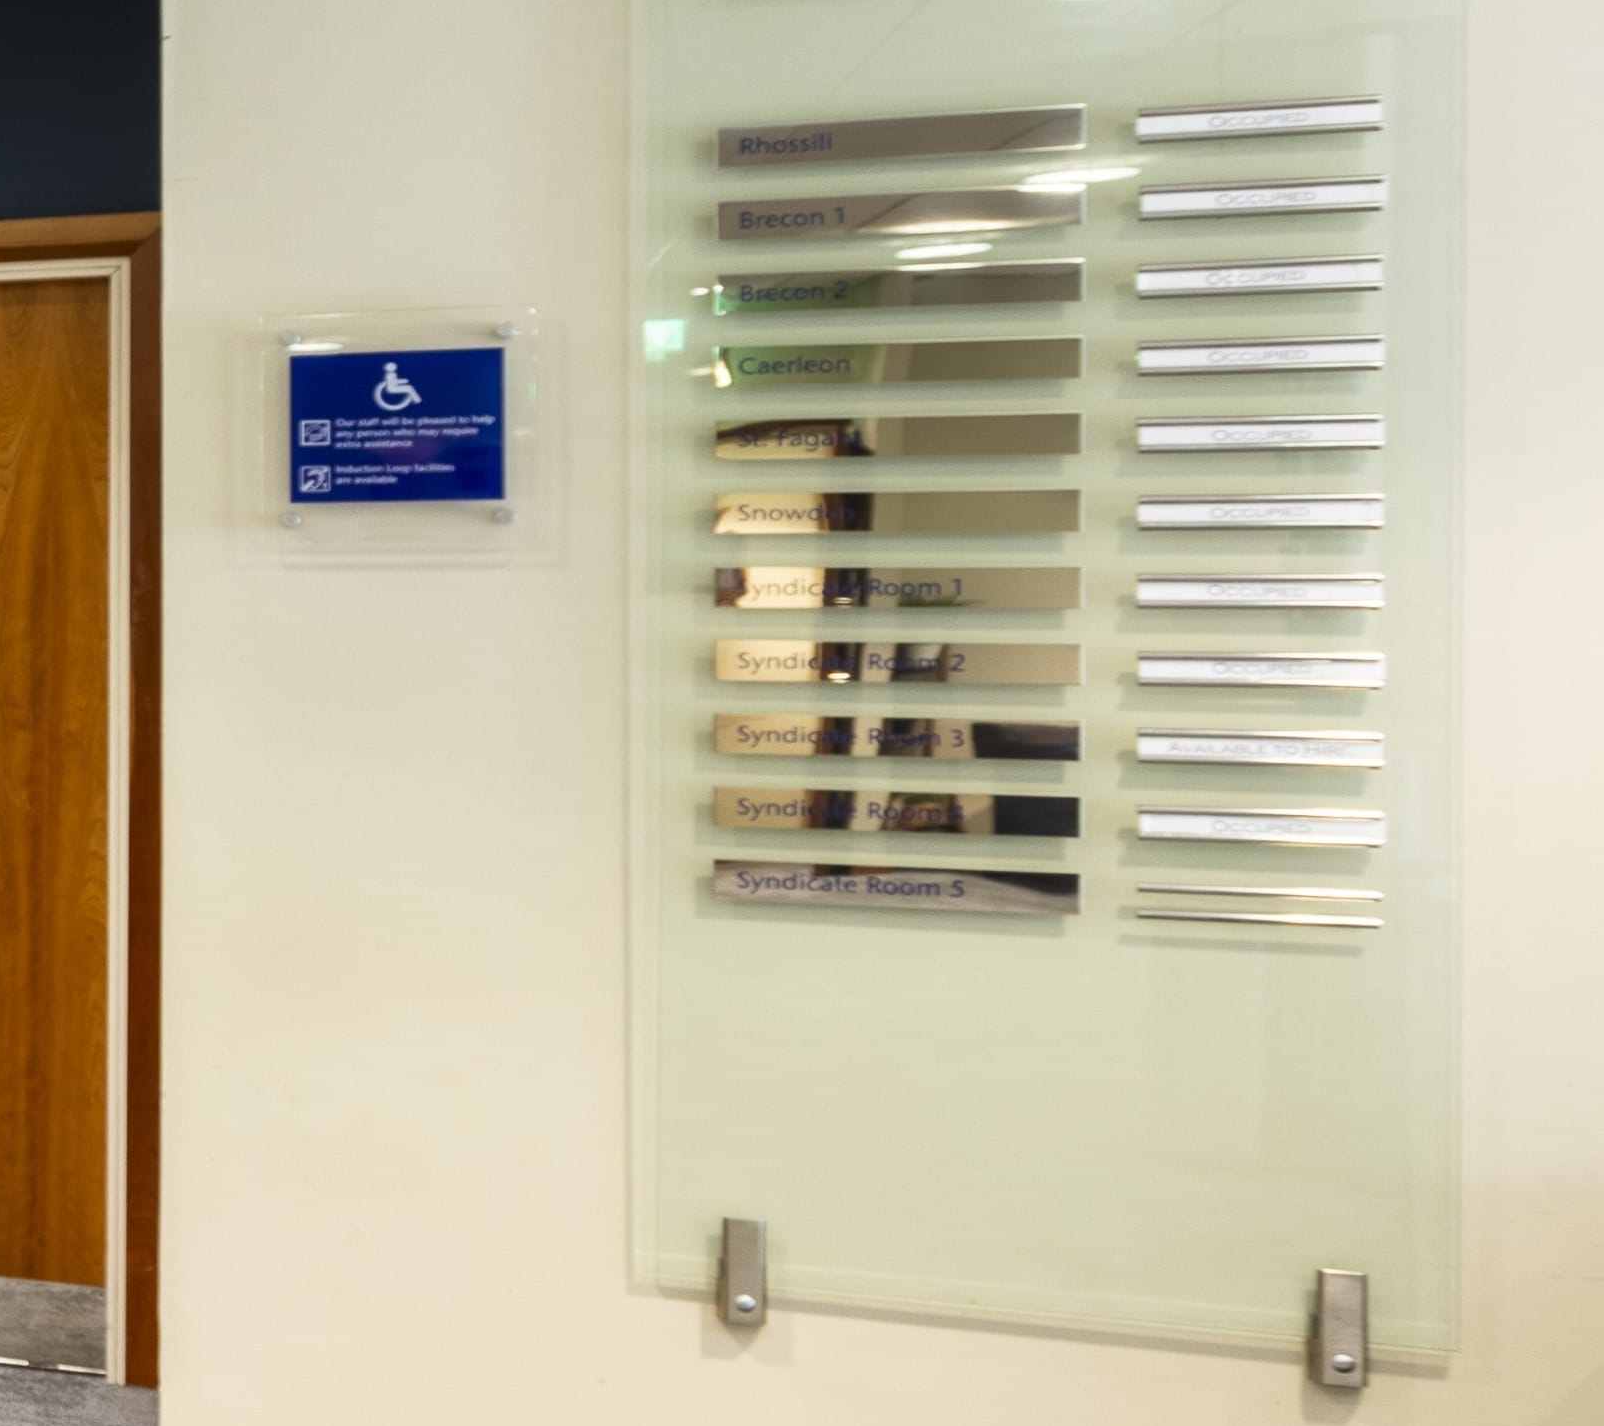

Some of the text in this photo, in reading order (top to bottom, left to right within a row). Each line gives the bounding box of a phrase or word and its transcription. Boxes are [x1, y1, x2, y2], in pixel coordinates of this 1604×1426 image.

[1207, 112, 1310, 128] OCCUPIED
[739, 133, 833, 155] Rhossili
[1215, 191, 1317, 206] OCCUPIED
[739, 206, 846, 230] Brecon 1
[739, 281, 849, 303] Brecon 2
[1208, 349, 1310, 363] OCCUPIED
[738, 356, 851, 376] Caerleon
[417, 416, 456, 427] pleased
[356, 430, 391, 439] person
[1210, 430, 1313, 442] OCCUPIED
[1209, 506, 1310, 519] OCCUPIED
[869, 578, 943, 597] Room
[951, 578, 963, 596] 1
[1207, 583, 1307, 598] OCCUPIED
[951, 653, 967, 672] 2
[950, 727, 966, 748] 3
[867, 801, 942, 822] Room
[1211, 820, 1311, 834] OCCUPIED
[735, 870, 966, 899] Syndicate Room 5
